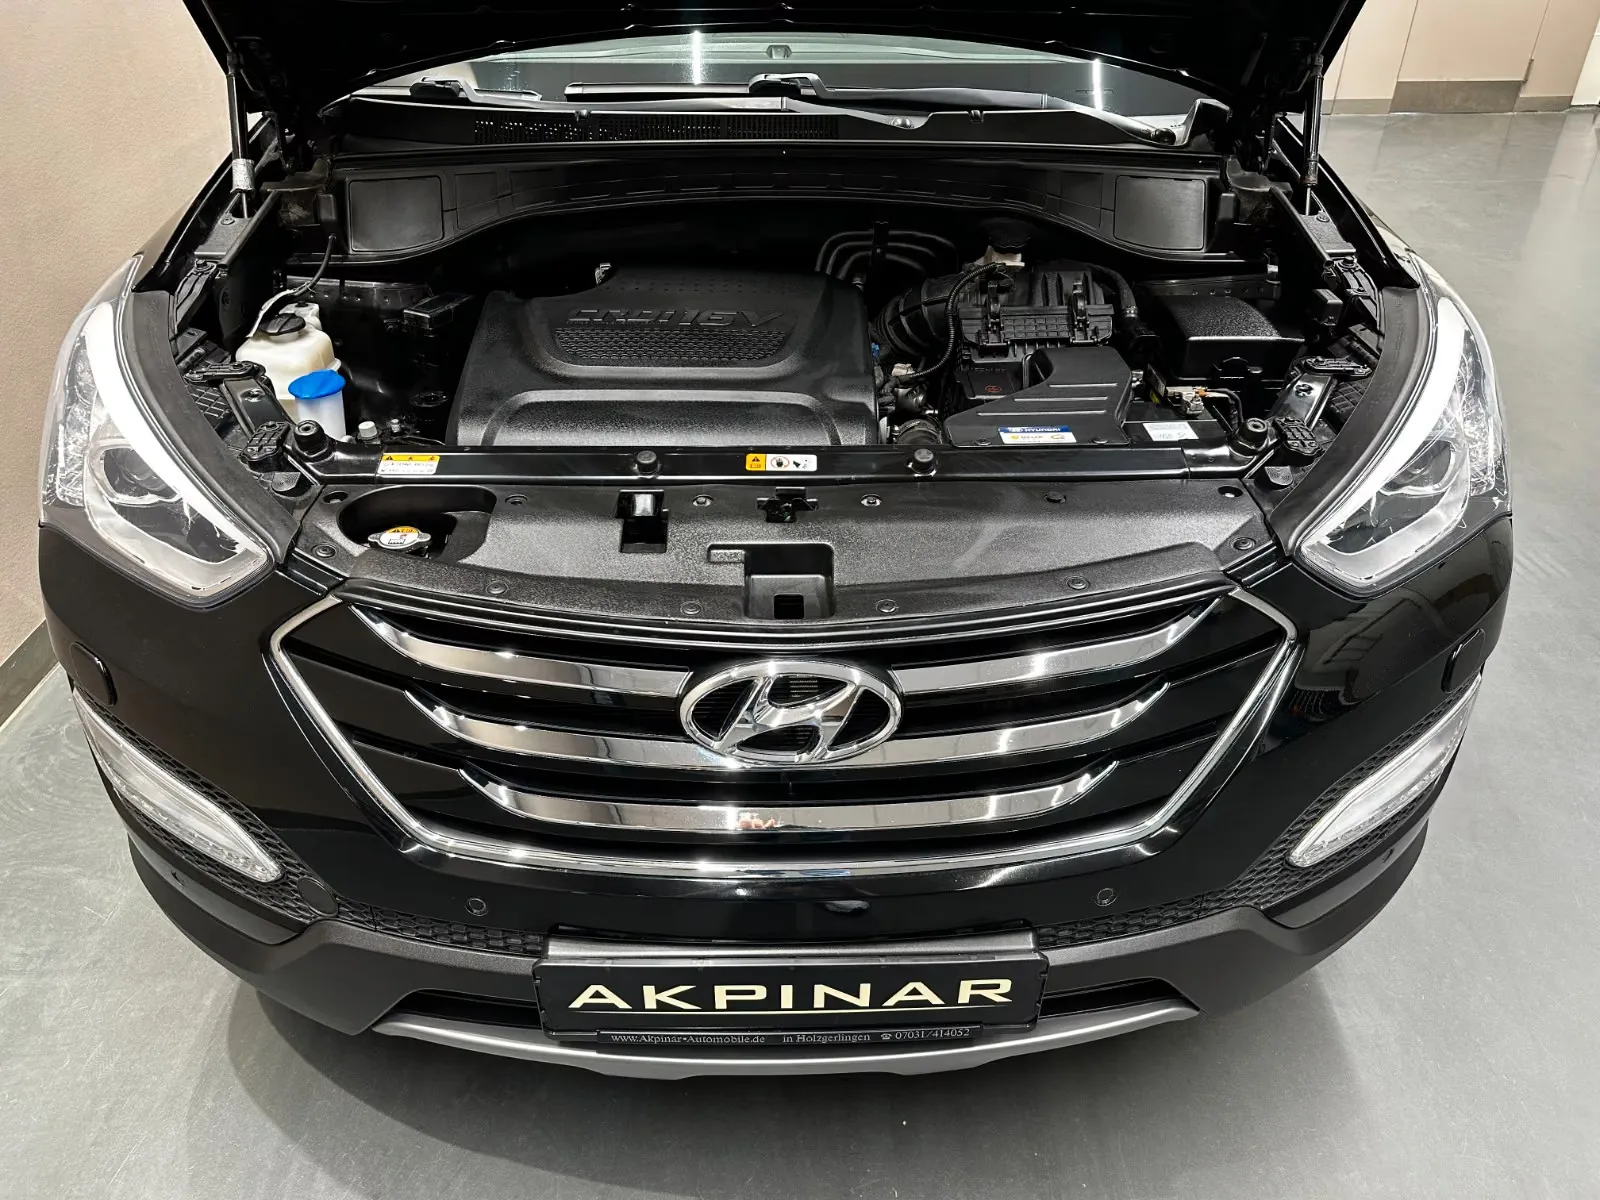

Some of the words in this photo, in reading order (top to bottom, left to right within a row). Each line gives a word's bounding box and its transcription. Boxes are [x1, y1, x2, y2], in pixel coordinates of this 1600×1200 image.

[568, 978, 1013, 1010] AKPINAR
[610, 1034, 766, 1044] www.Akpinar-Automobile.de
[783, 1034, 793, 1043] in
[796, 1033, 871, 1044] Holzgerlingen
[895, 1028, 970, 1040] 07031/414052
